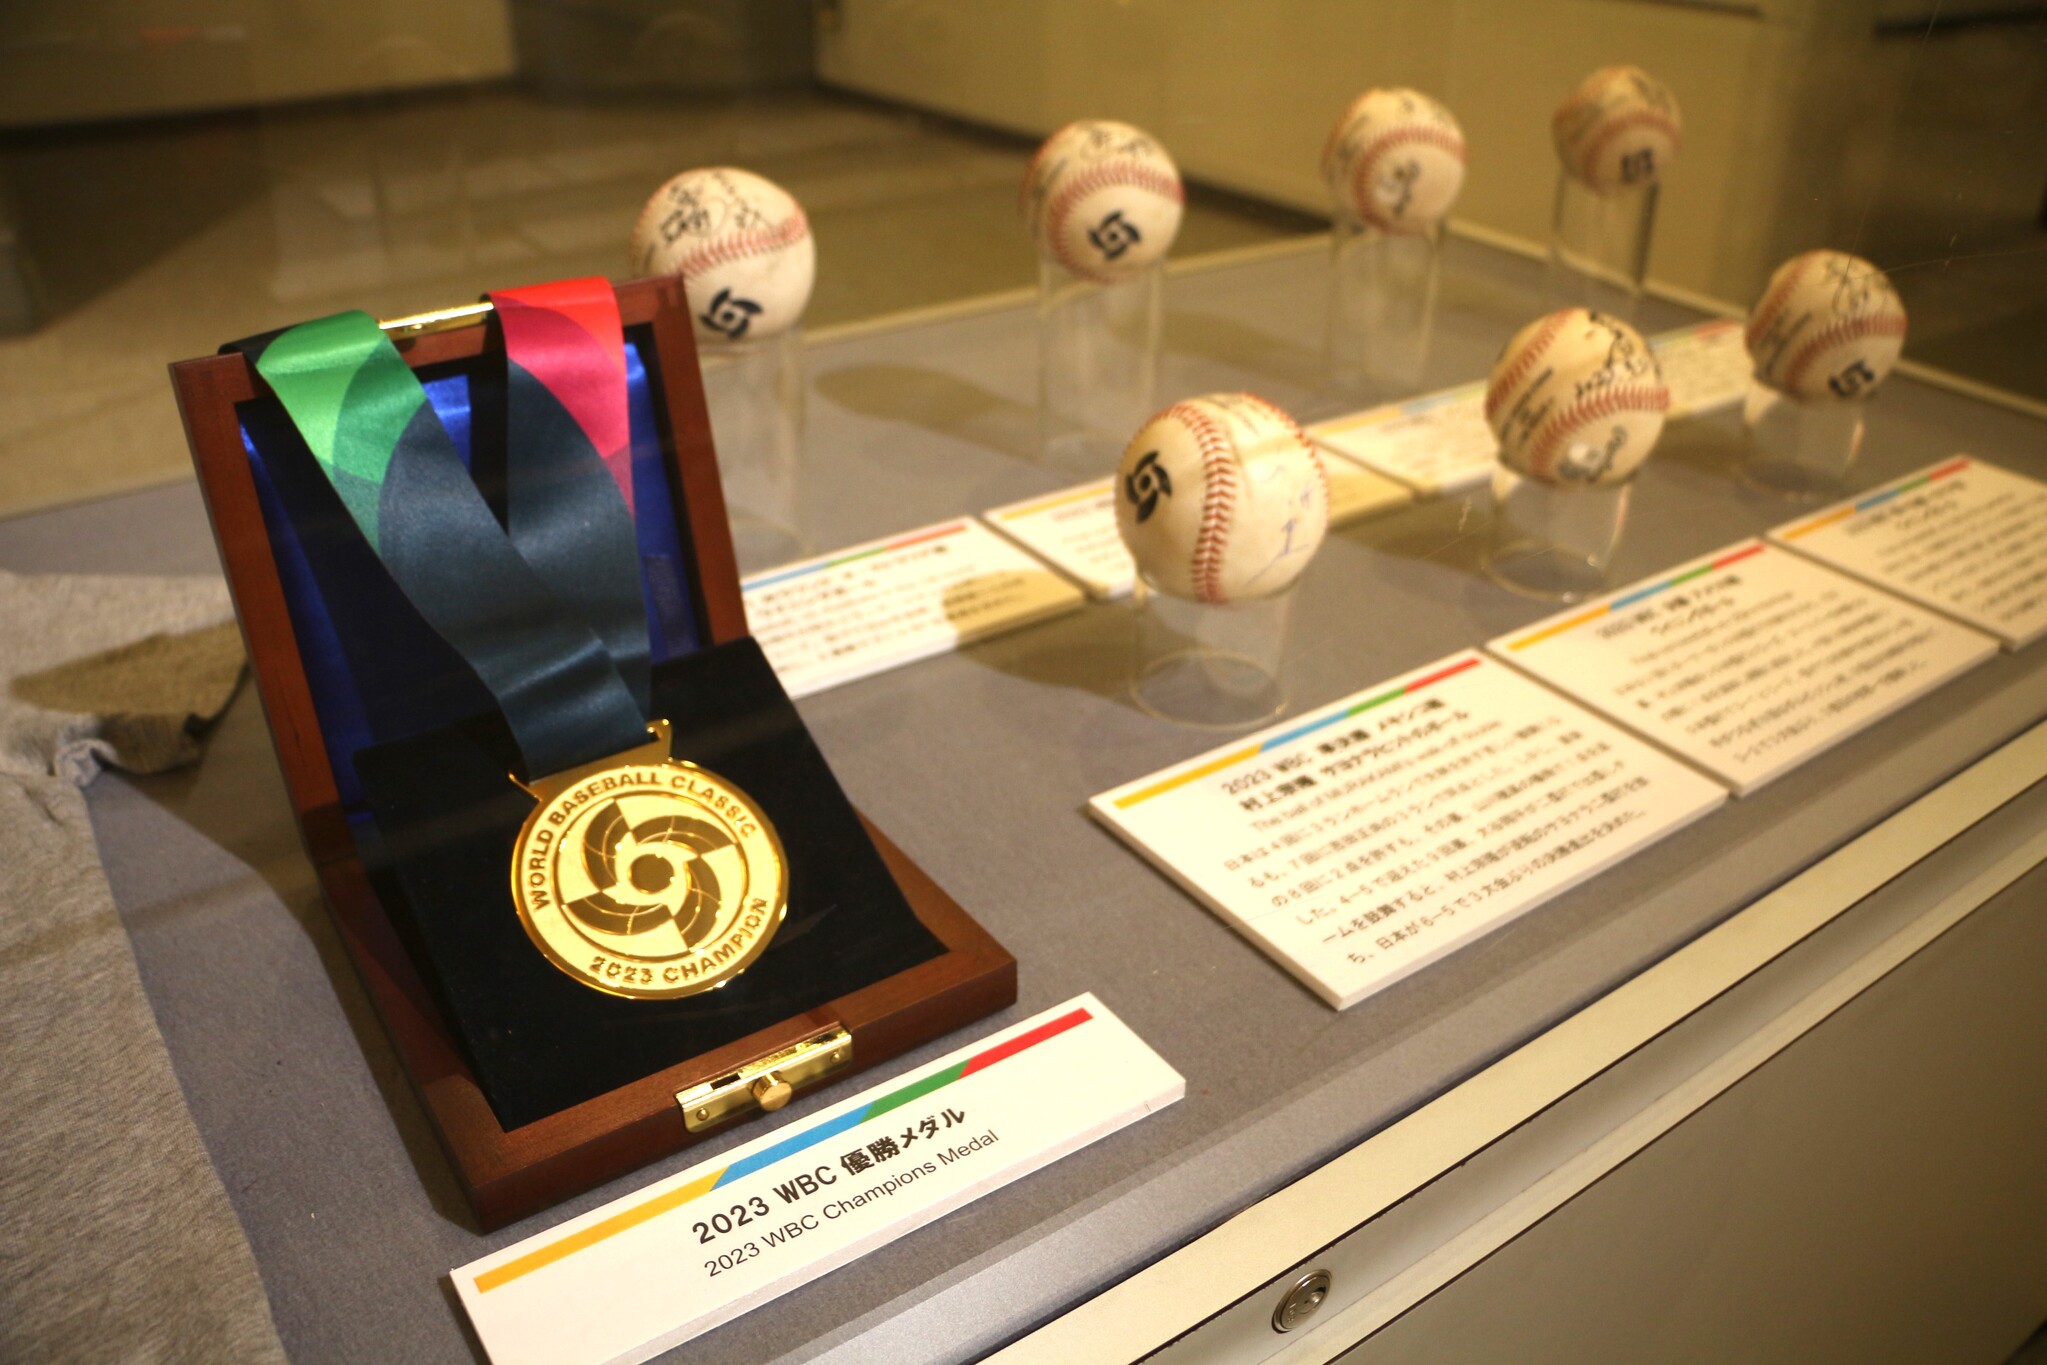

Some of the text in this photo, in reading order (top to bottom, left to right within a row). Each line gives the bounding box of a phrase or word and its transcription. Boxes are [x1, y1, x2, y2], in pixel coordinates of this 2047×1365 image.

[529, 770, 758, 911] WORLD BASEBALL CLASSIC
[1221, 769, 1273, 796] 2023
[588, 897, 769, 985] 2023 CHAMPION
[692, 1108, 965, 1245] 2023 WBC 優勝メダル
[704, 1129, 1000, 1277] 2023 WBC Champions Medal
